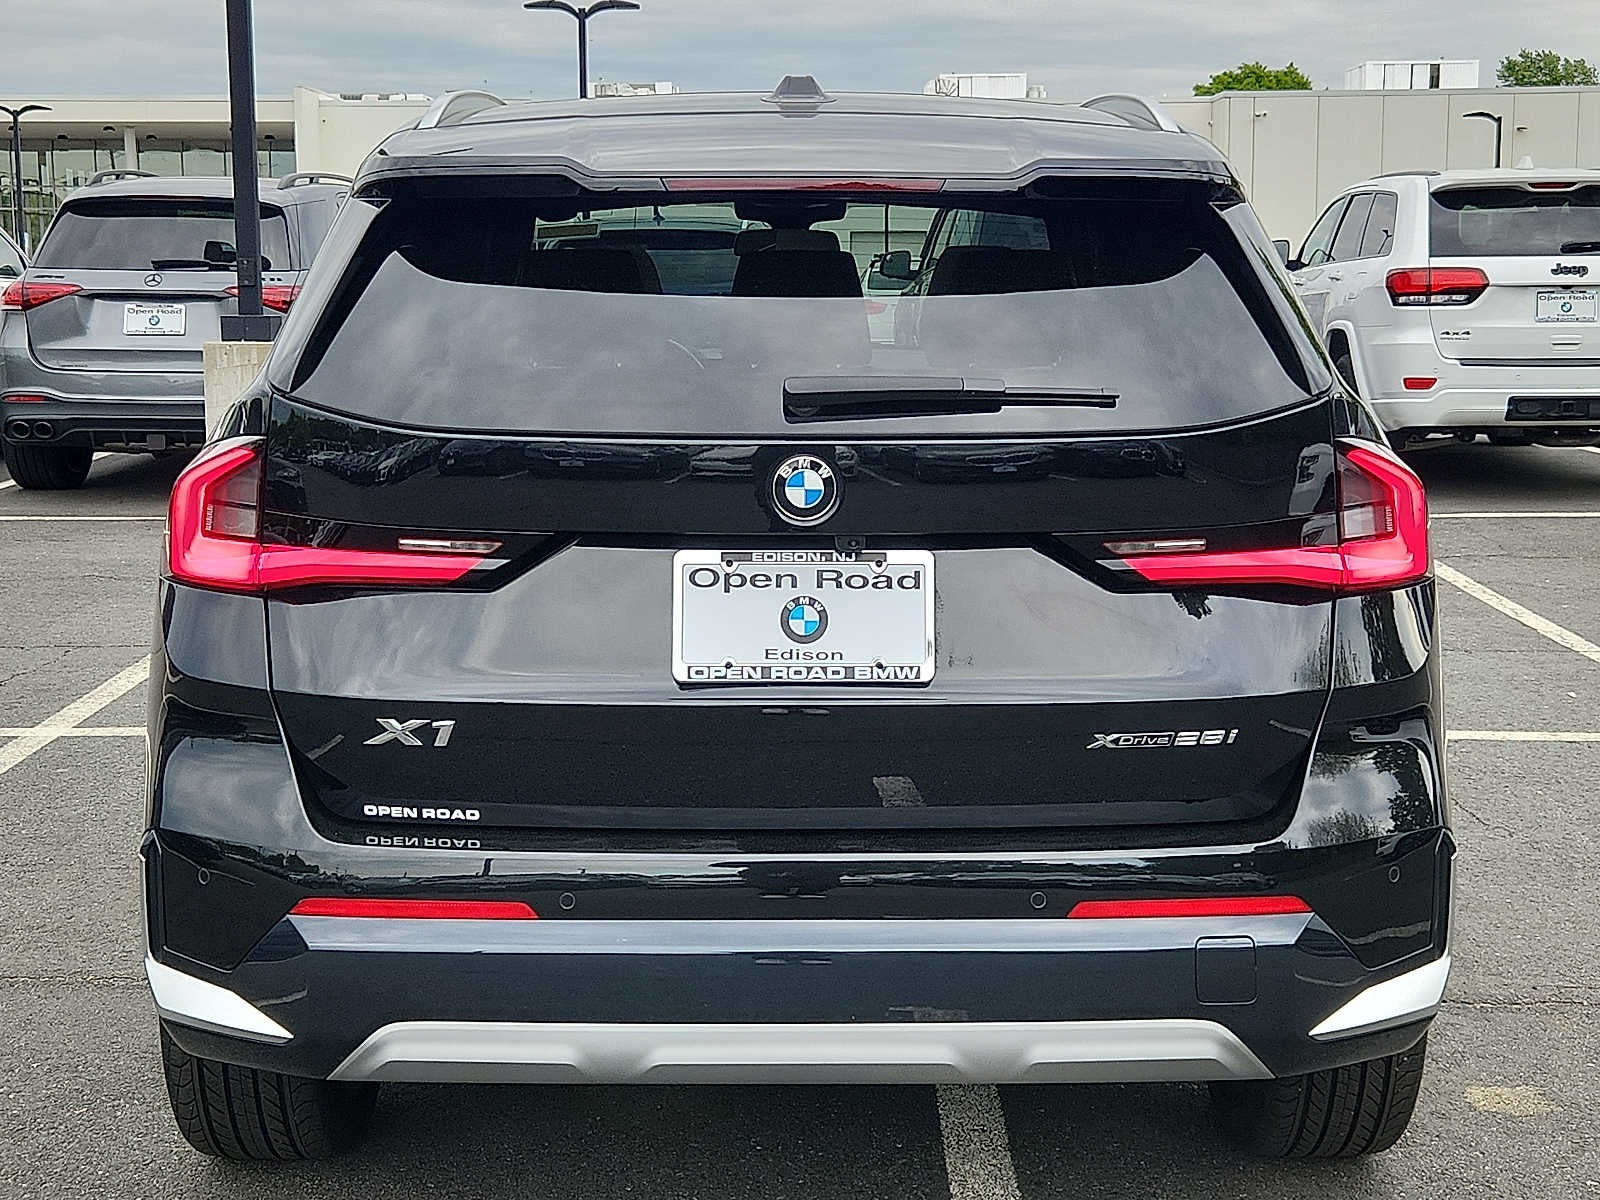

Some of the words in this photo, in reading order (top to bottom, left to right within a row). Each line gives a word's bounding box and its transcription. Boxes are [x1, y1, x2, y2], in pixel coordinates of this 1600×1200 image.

[1551, 263, 1588, 278] Jeep
[779, 458, 831, 479] BMW
[832, 552, 857, 563] NJ
[688, 567, 798, 594] Open
[816, 569, 921, 590] Road
[786, 596, 824, 612] BMW
[764, 648, 843, 661] Edison
[689, 665, 762, 680] OPEN
[770, 665, 846, 680] ROAD
[854, 665, 920, 680] BMW
[363, 717, 456, 747] X1
[363, 804, 418, 818] OPEN
[422, 808, 481, 820] ROAD
